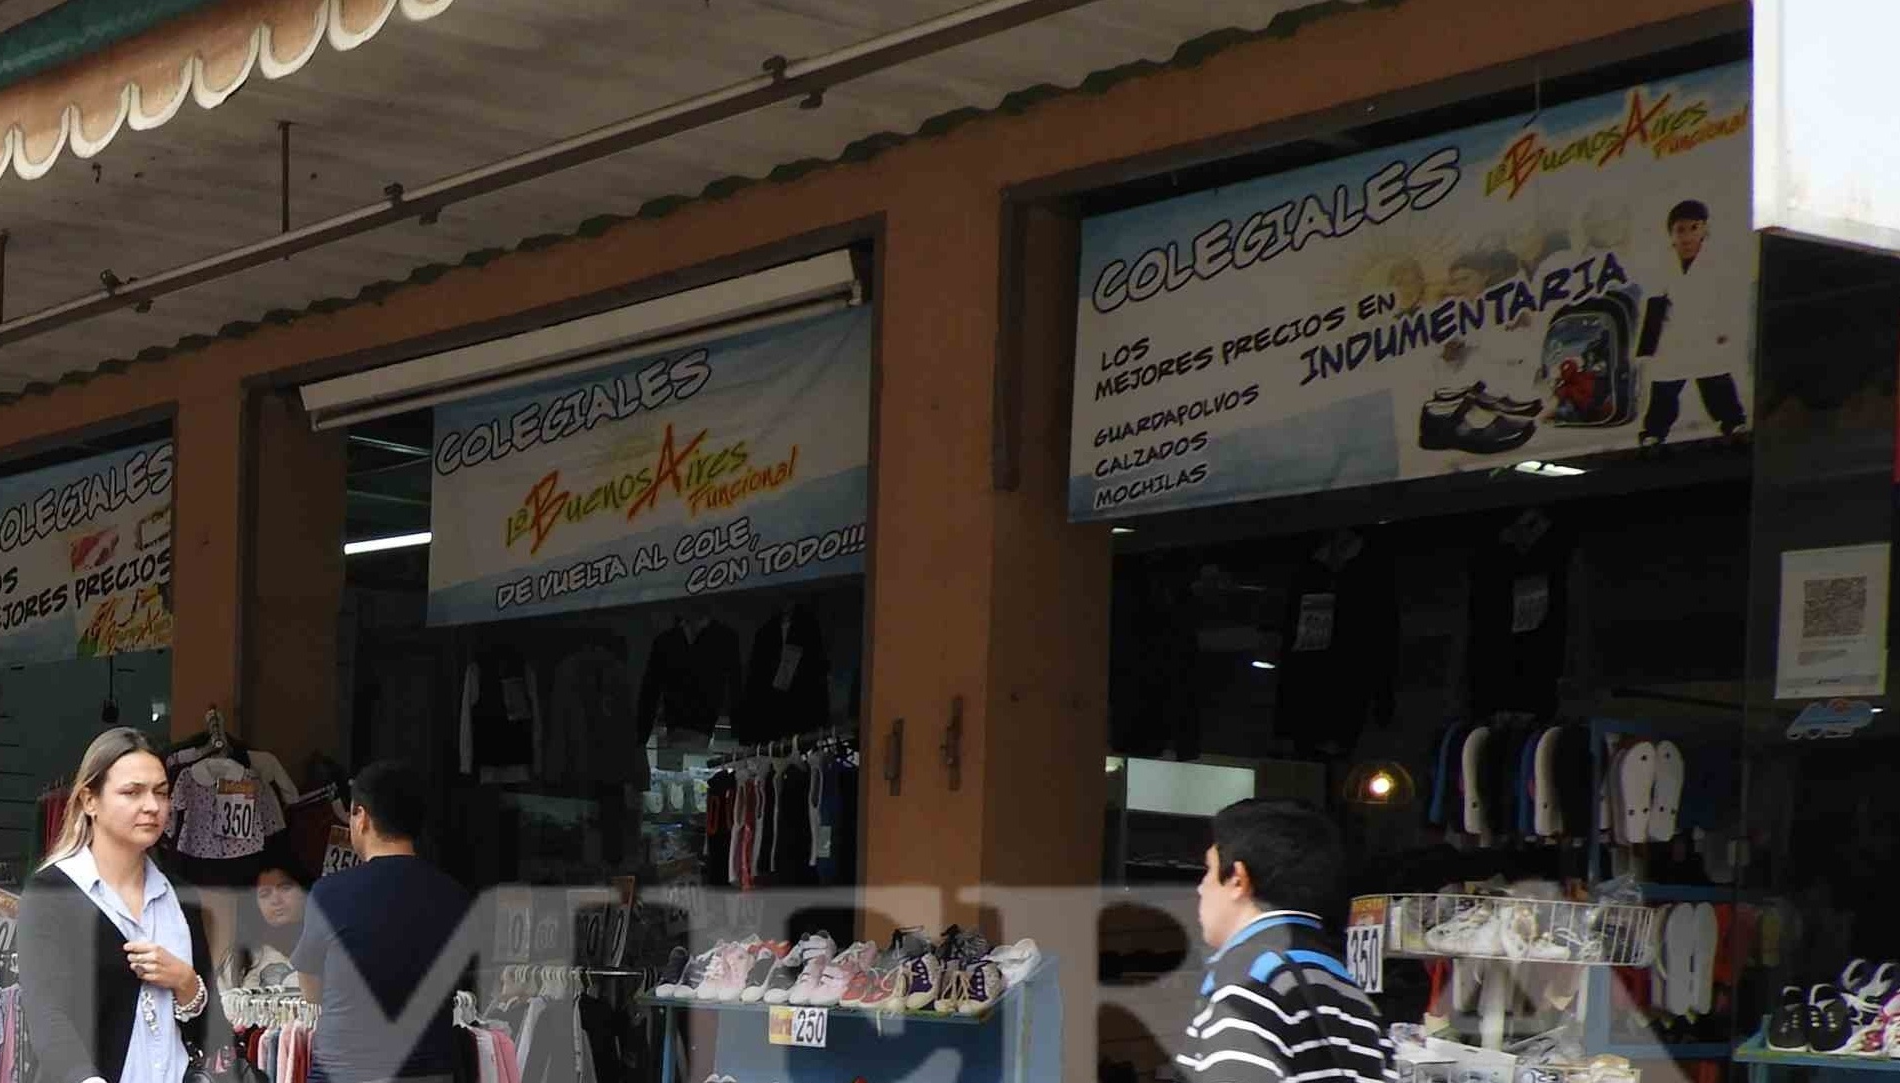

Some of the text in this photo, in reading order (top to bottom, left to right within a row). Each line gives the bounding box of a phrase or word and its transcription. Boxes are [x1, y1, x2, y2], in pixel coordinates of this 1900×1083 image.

[1092, 147, 1462, 313] COLEGIALES
[1094, 292, 1397, 402] MEJORES PRECIOS EN
[1300, 252, 1628, 386] INDUMENTARIA
[1101, 337, 1151, 373] LOS
[435, 348, 713, 477] COLEGIALES
[1094, 384, 1260, 449] GUARDAPOLVOS
[688, 445, 799, 519] Funcional
[1094, 430, 1209, 478] CALZADOS
[1094, 463, 1209, 510] MOCHILAS
[75, 547, 171, 609] PRECIOS
[496, 516, 761, 611] DE VUELTA AL COLE,
[687, 525, 867, 594] CON TODO!!!
[221, 801, 252, 838] 350
[1349, 929, 1379, 990] 350
[794, 1009, 826, 1043] 250
